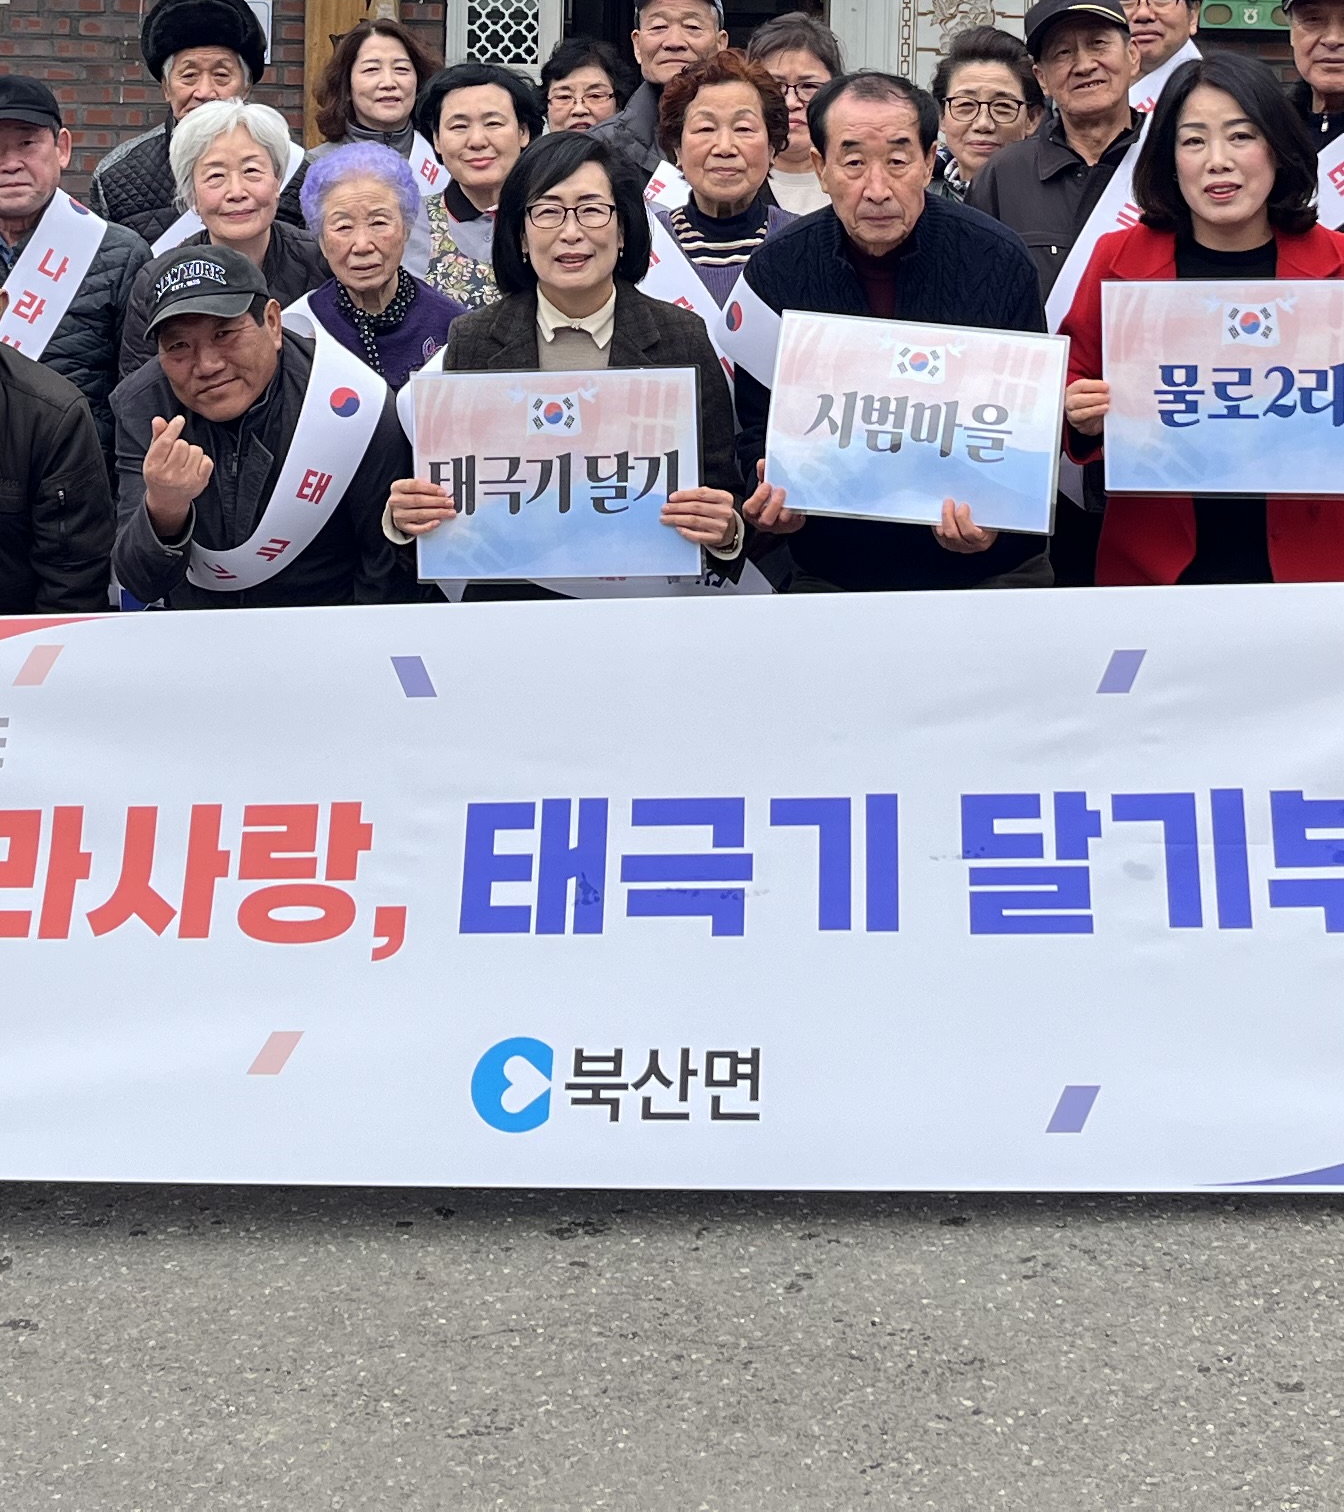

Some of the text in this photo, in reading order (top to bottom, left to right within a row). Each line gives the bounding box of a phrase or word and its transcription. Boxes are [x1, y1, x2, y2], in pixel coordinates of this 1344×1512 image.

[182, 259, 227, 285] YORK
[804, 391, 1013, 463] 시범마을
[428, 449, 680, 516] 태극기 달기
[459, 793, 899, 937] 태극기
[565, 1046, 761, 1123] 북산면
